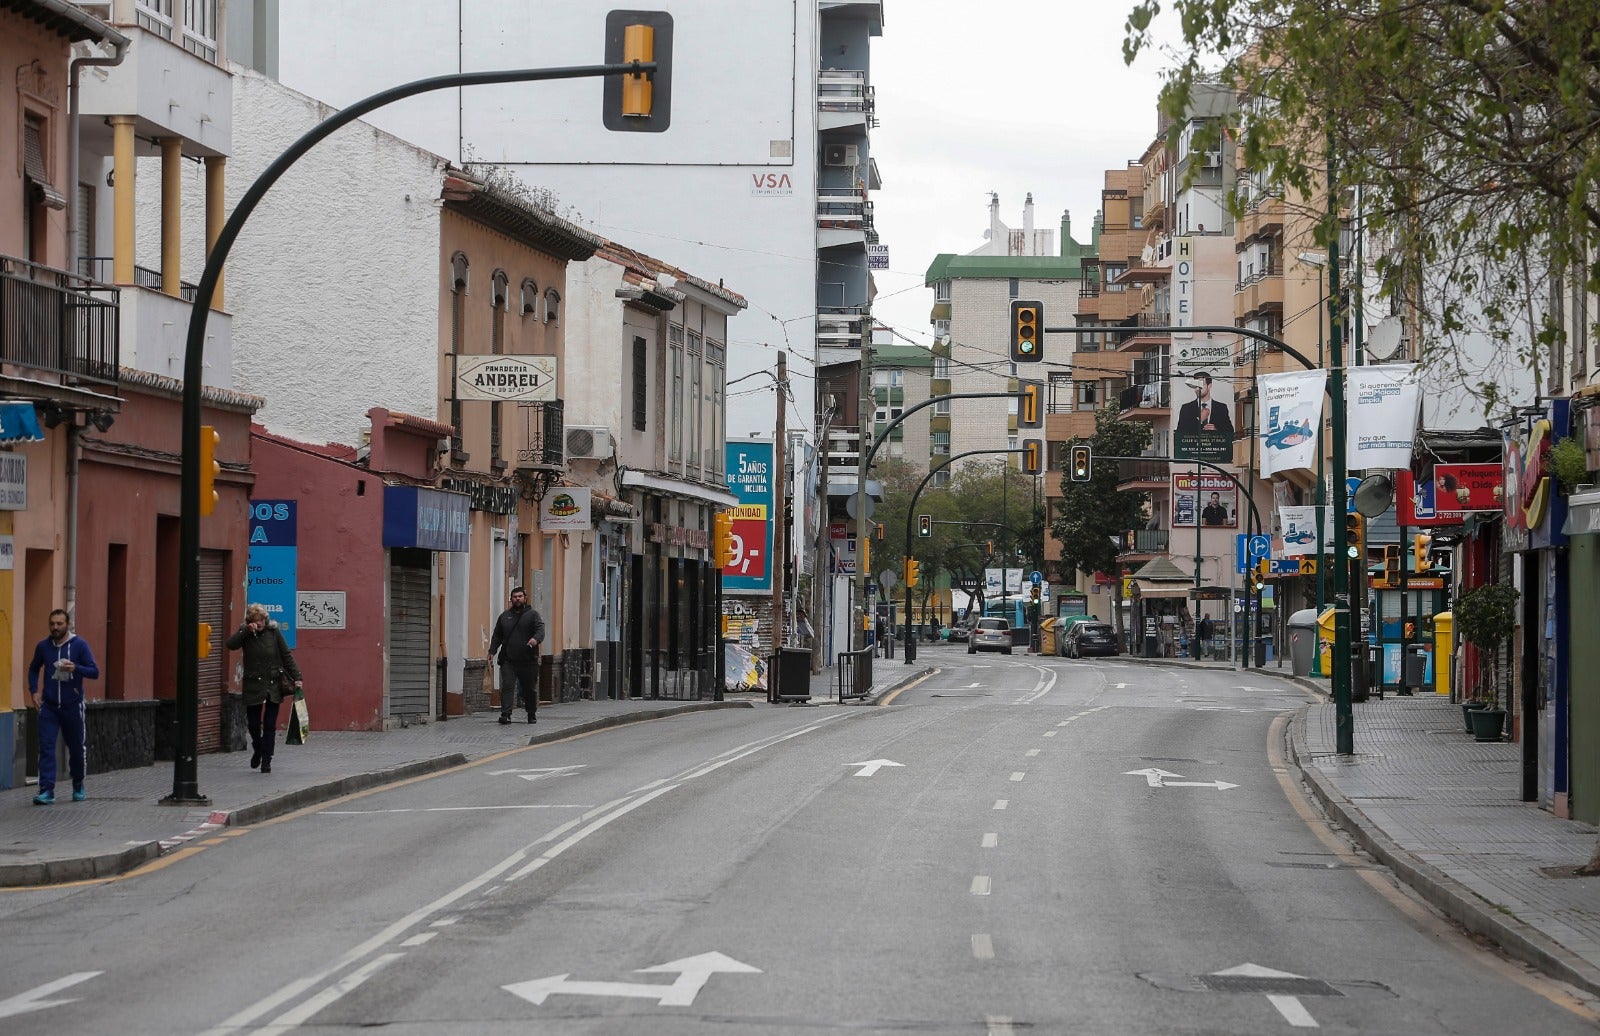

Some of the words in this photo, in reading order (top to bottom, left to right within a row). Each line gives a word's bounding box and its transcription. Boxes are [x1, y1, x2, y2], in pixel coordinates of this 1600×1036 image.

[752, 173, 792, 188] VSA
[475, 373, 539, 387] ANDREU
[739, 454, 746, 474] 5
[748, 461, 767, 474] AÑOS
[728, 474, 736, 483] DE
[738, 473, 767, 484] GARANTÍA
[726, 508, 761, 518] RTUNIDAD
[1269, 561, 1279, 573] P
[255, 576, 284, 585] bebes
